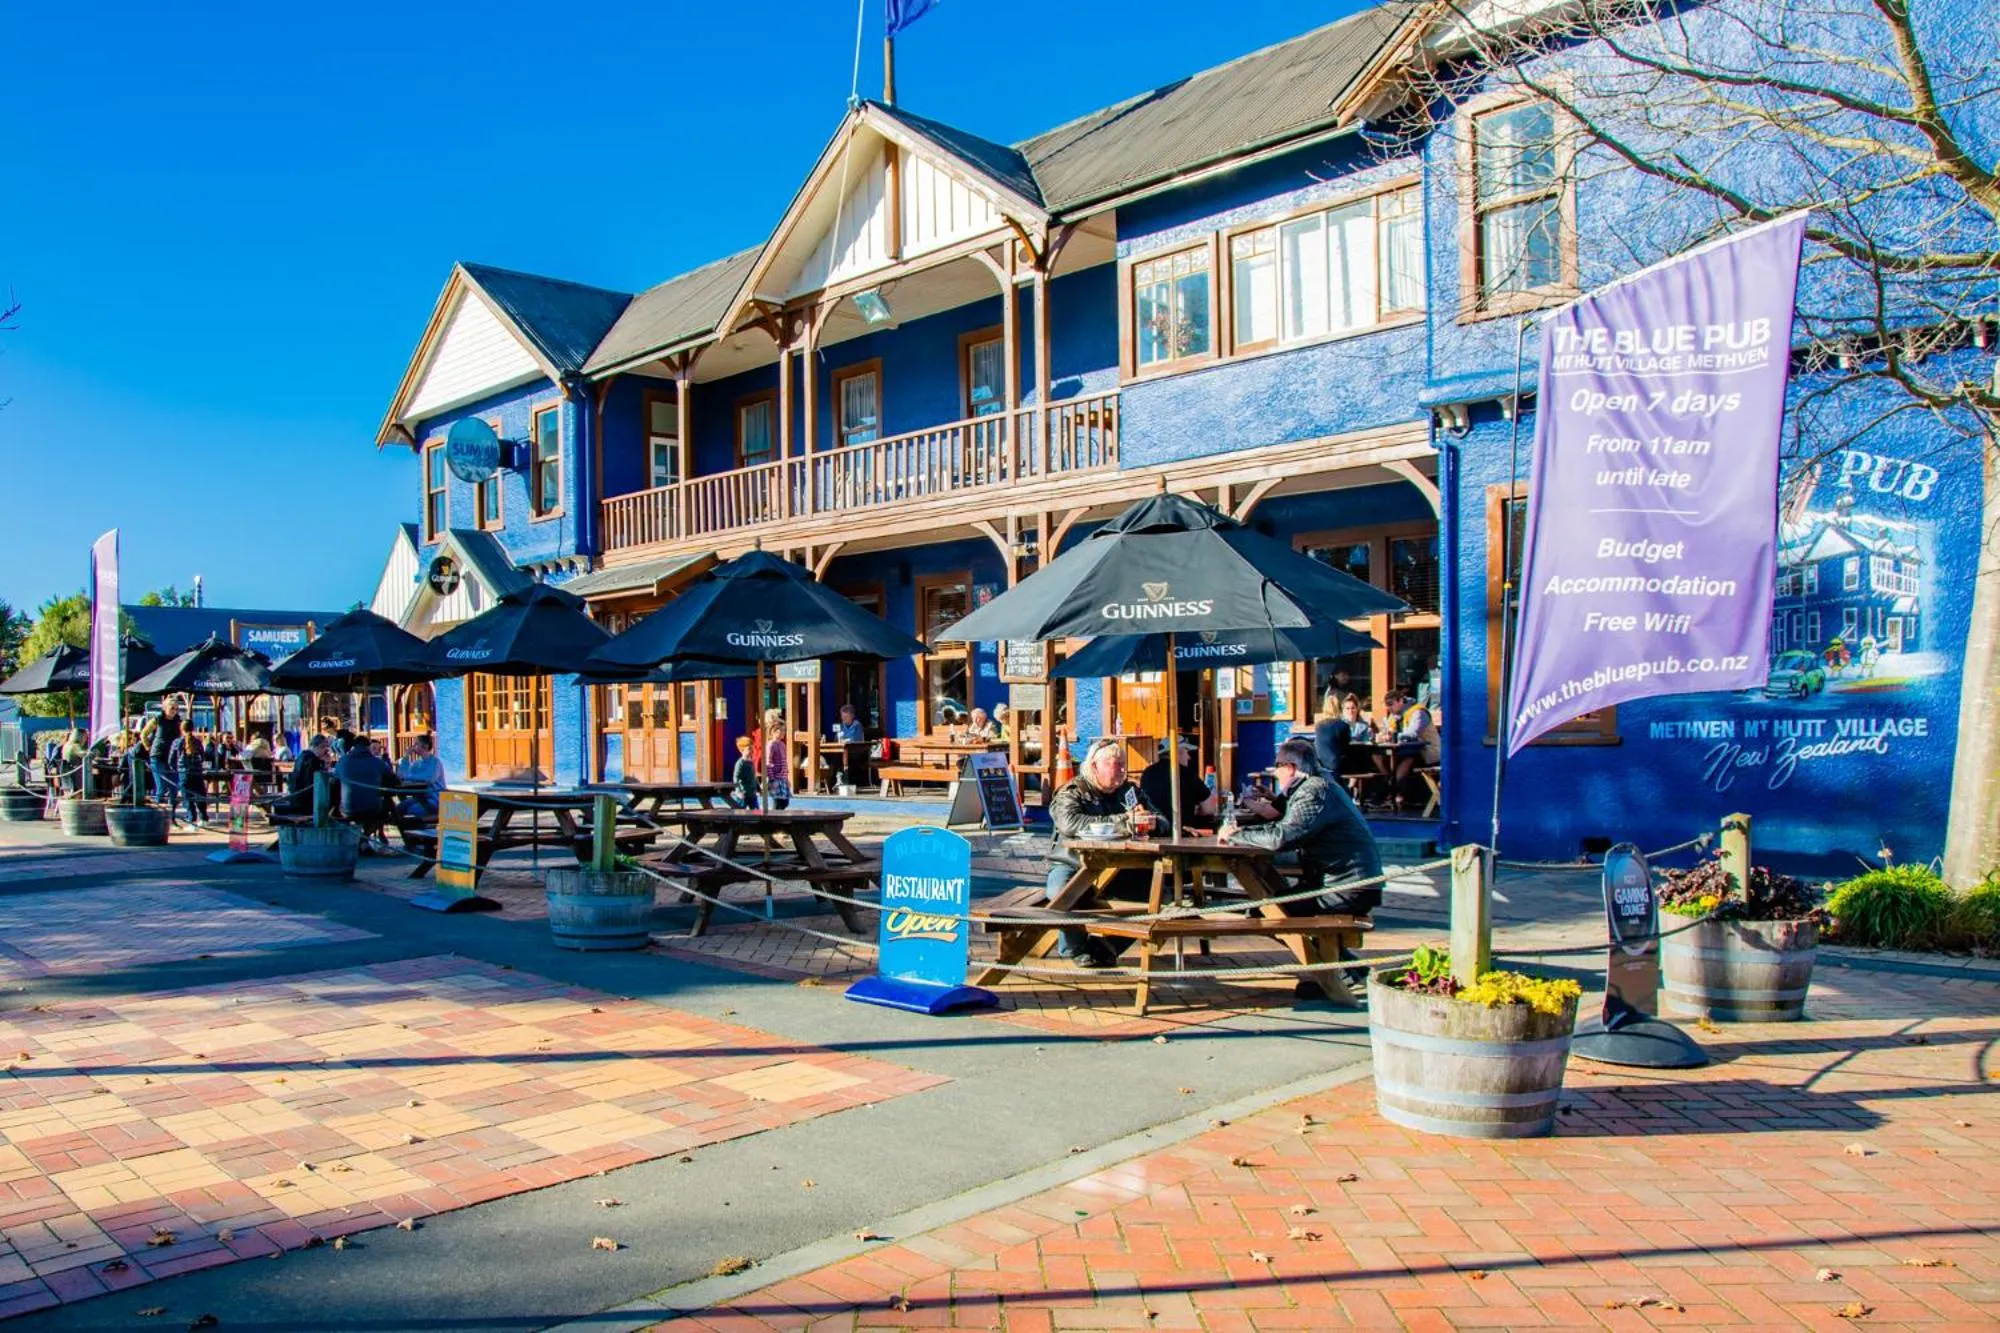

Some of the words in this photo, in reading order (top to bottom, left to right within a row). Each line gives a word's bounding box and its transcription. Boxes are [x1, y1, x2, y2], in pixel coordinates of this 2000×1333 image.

[1555, 326, 1608, 353] THE
[1615, 325, 1696, 354] BLUE
[1704, 318, 1771, 350] PUB
[1615, 354, 1682, 371] VILLAGE
[1687, 346, 1769, 368] METHVEN
[1570, 388, 1637, 415] Open
[1647, 391, 1665, 411] 7
[1671, 390, 1742, 417] days
[1586, 434, 1641, 454] From
[1650, 436, 1711, 456] 11am
[1596, 467, 1644, 486] until
[1648, 468, 1691, 488] late
[1833, 449, 1939, 500] PUB
[1597, 538, 1685, 563] Budget
[1544, 576, 1736, 596] Accommodation
[1102, 601, 1212, 619] GUINNESS
[1584, 612, 1637, 632] Free
[1644, 612, 1692, 634] Wifi
[726, 632, 804, 647] GUINNESS
[1174, 644, 1247, 659] GUINNESS
[308, 659, 357, 669] GUINNESS
[1515, 655, 1749, 729] www.thebluepub.co.nz
[1650, 721, 1735, 739] METHVEN
[1774, 720, 1827, 738] HUTT
[1836, 718, 1928, 737] VILLAGE
[1703, 742, 1769, 792] New
[1768, 733, 1887, 790] Zealand
[886, 874, 965, 905] RESTAURANT
[1614, 887, 1650, 905] GAMING
[886, 906, 960, 936] Open
[1620, 904, 1647, 917] LOUNGE
